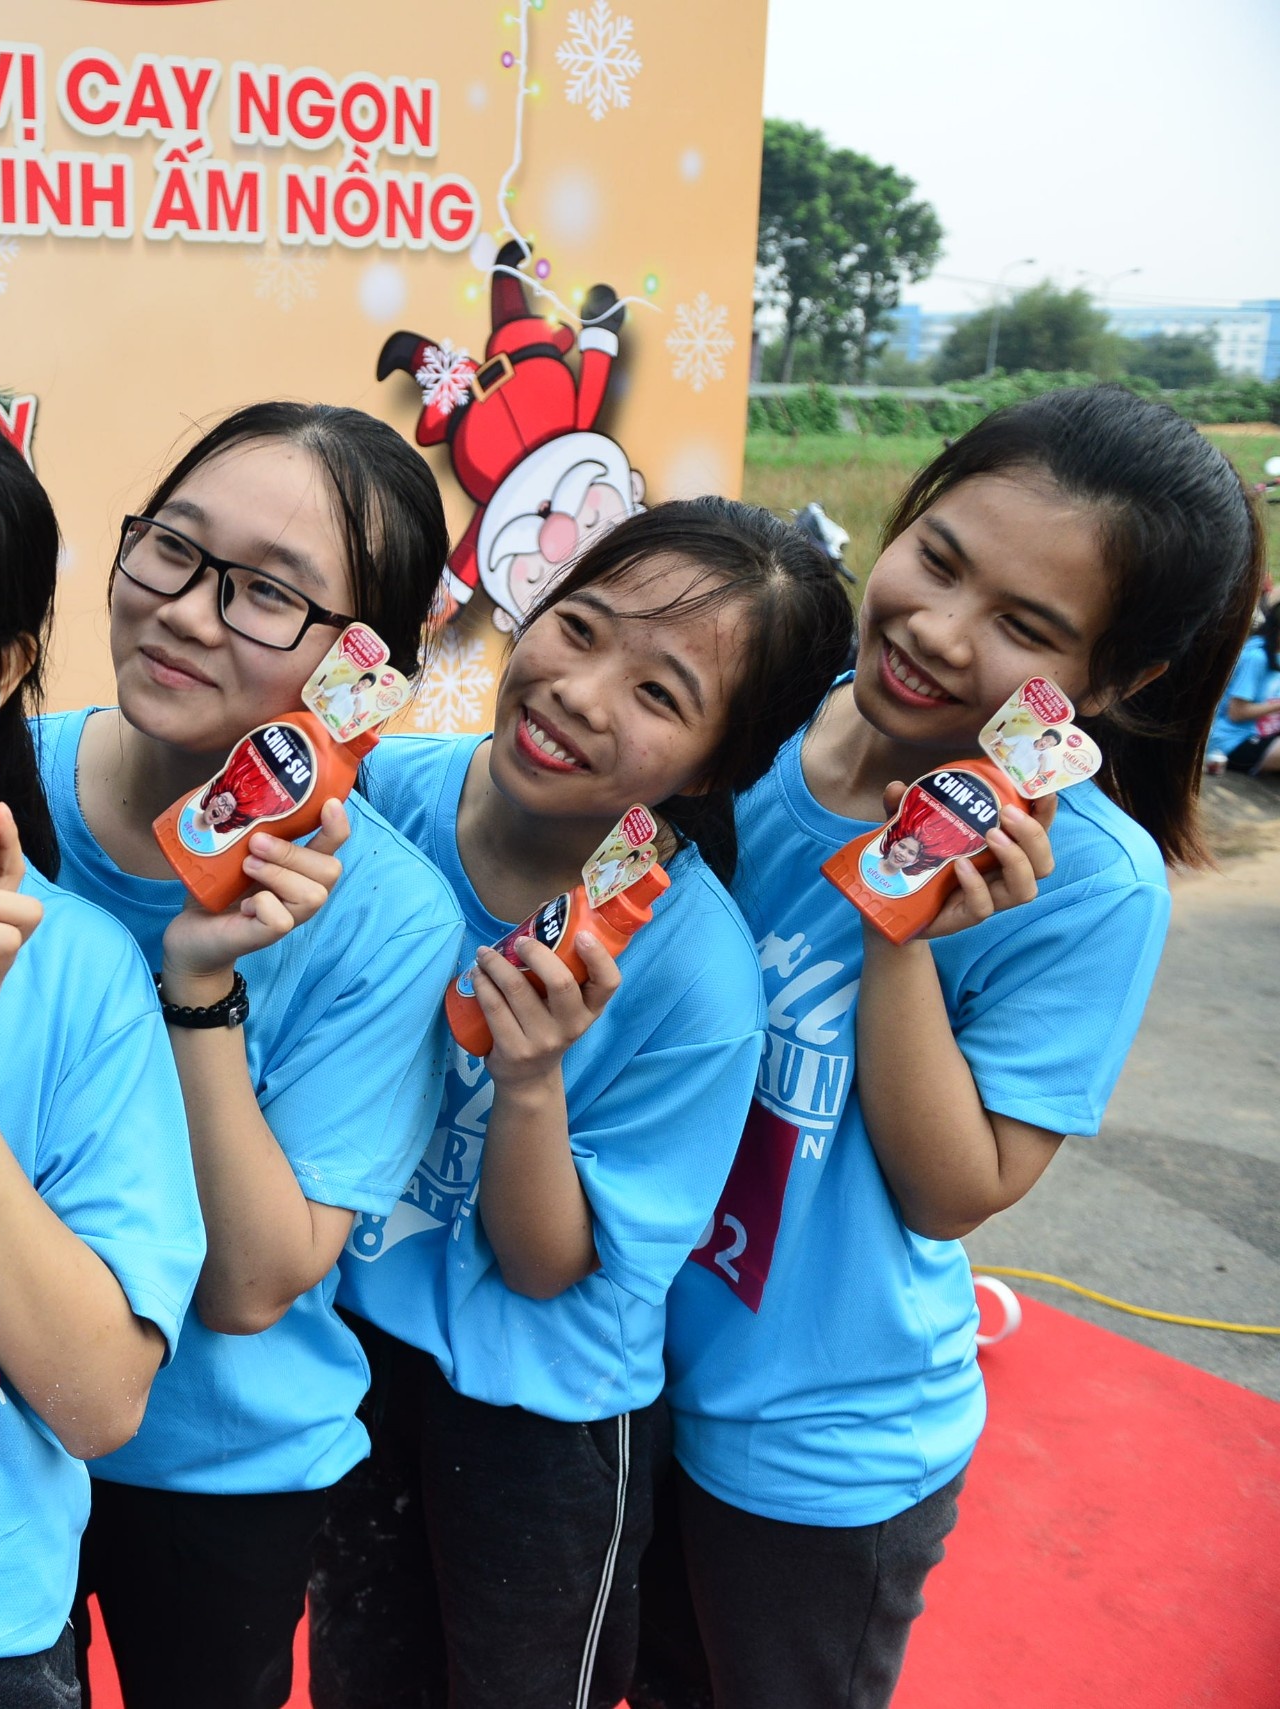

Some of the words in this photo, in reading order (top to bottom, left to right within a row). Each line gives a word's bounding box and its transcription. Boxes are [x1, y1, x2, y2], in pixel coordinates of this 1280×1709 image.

[66, 59, 212, 130] CAY
[238, 71, 432, 147] NGON
[153, 139, 258, 232] ẤM
[287, 145, 474, 242] NỒNG
[262, 726, 311, 785] CHIN-SU
[933, 771, 997, 824] CHIN-SU
[867, 866, 880, 879] SIÊU
[879, 878, 891, 888] CAY
